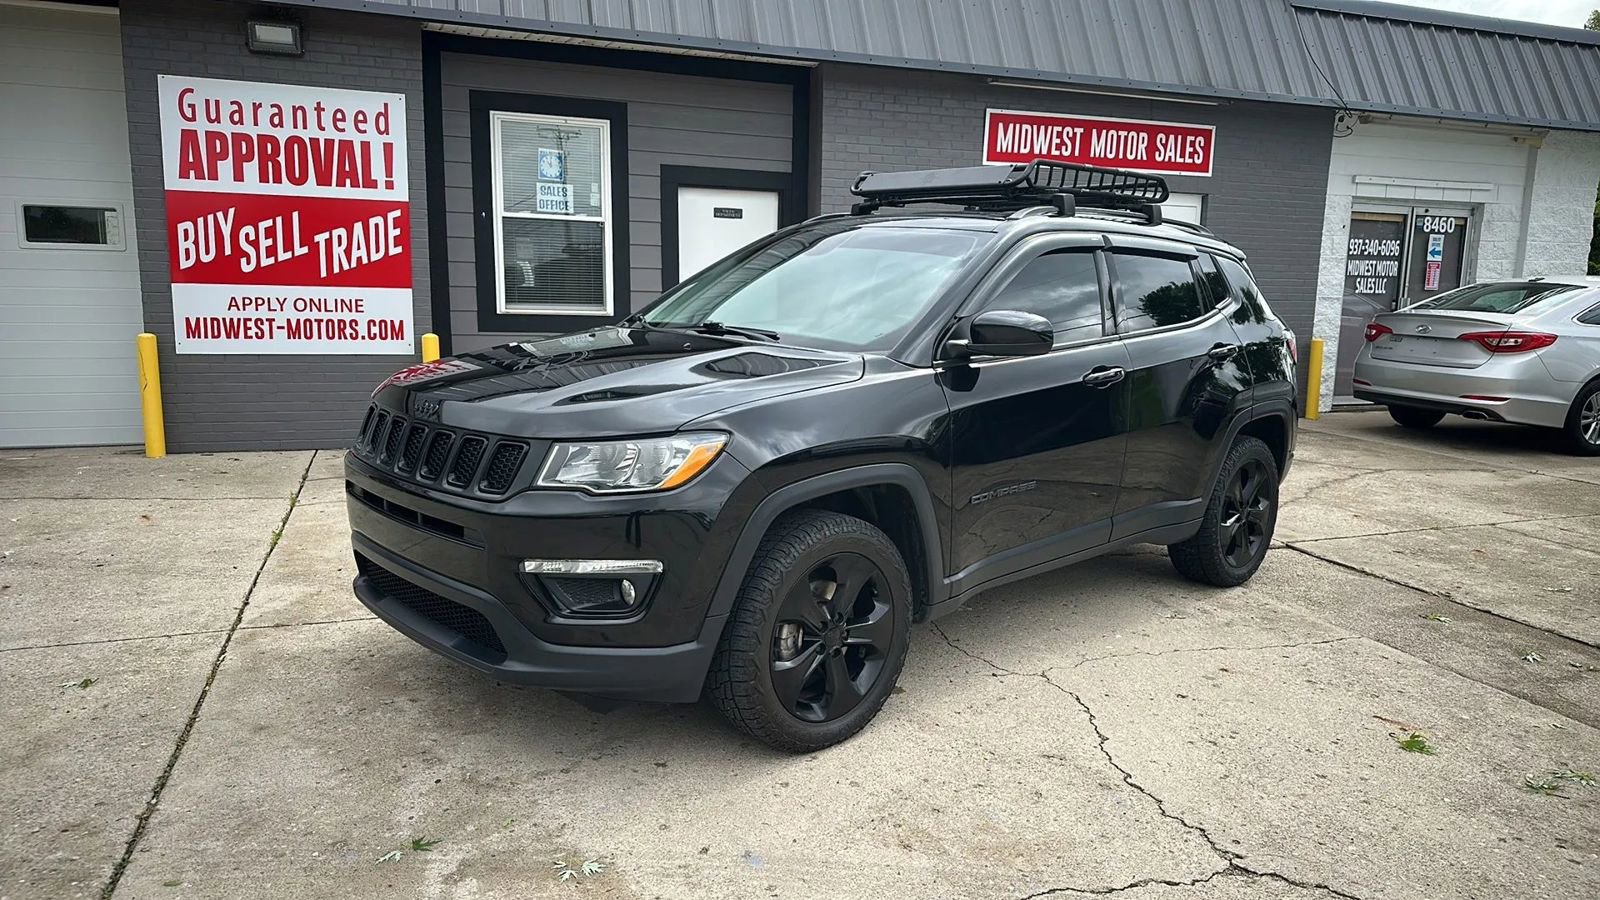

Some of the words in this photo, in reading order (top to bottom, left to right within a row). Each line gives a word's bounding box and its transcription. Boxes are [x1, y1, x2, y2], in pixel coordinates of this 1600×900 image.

[178, 88, 390, 135] Guaranteed
[996, 122, 1084, 157] MIDWEST
[1089, 128, 1148, 161] MOTOR
[1155, 133, 1205, 165] SALES
[178, 128, 395, 190] APPROVAL!
[540, 185, 568, 198] SALES
[539, 199, 570, 211] OFFICE
[1423, 216, 1456, 233] 8460
[177, 207, 236, 270] BUY
[239, 211, 309, 273] SELL
[314, 209, 403, 278] TRADE
[1349, 239, 1400, 256] 937-340-6096
[1347, 260, 1377, 276] MIDWEST
[1376, 260, 1398, 277] MOTOR
[1355, 278, 1376, 293] SALES
[1375, 278, 1387, 294] LLC
[227, 296, 288, 312] APPLY
[293, 297, 365, 313] ONLINE
[185, 316, 405, 341] MIDWEST-MOTORS.COM
[971, 480, 1037, 504] COMPASS
